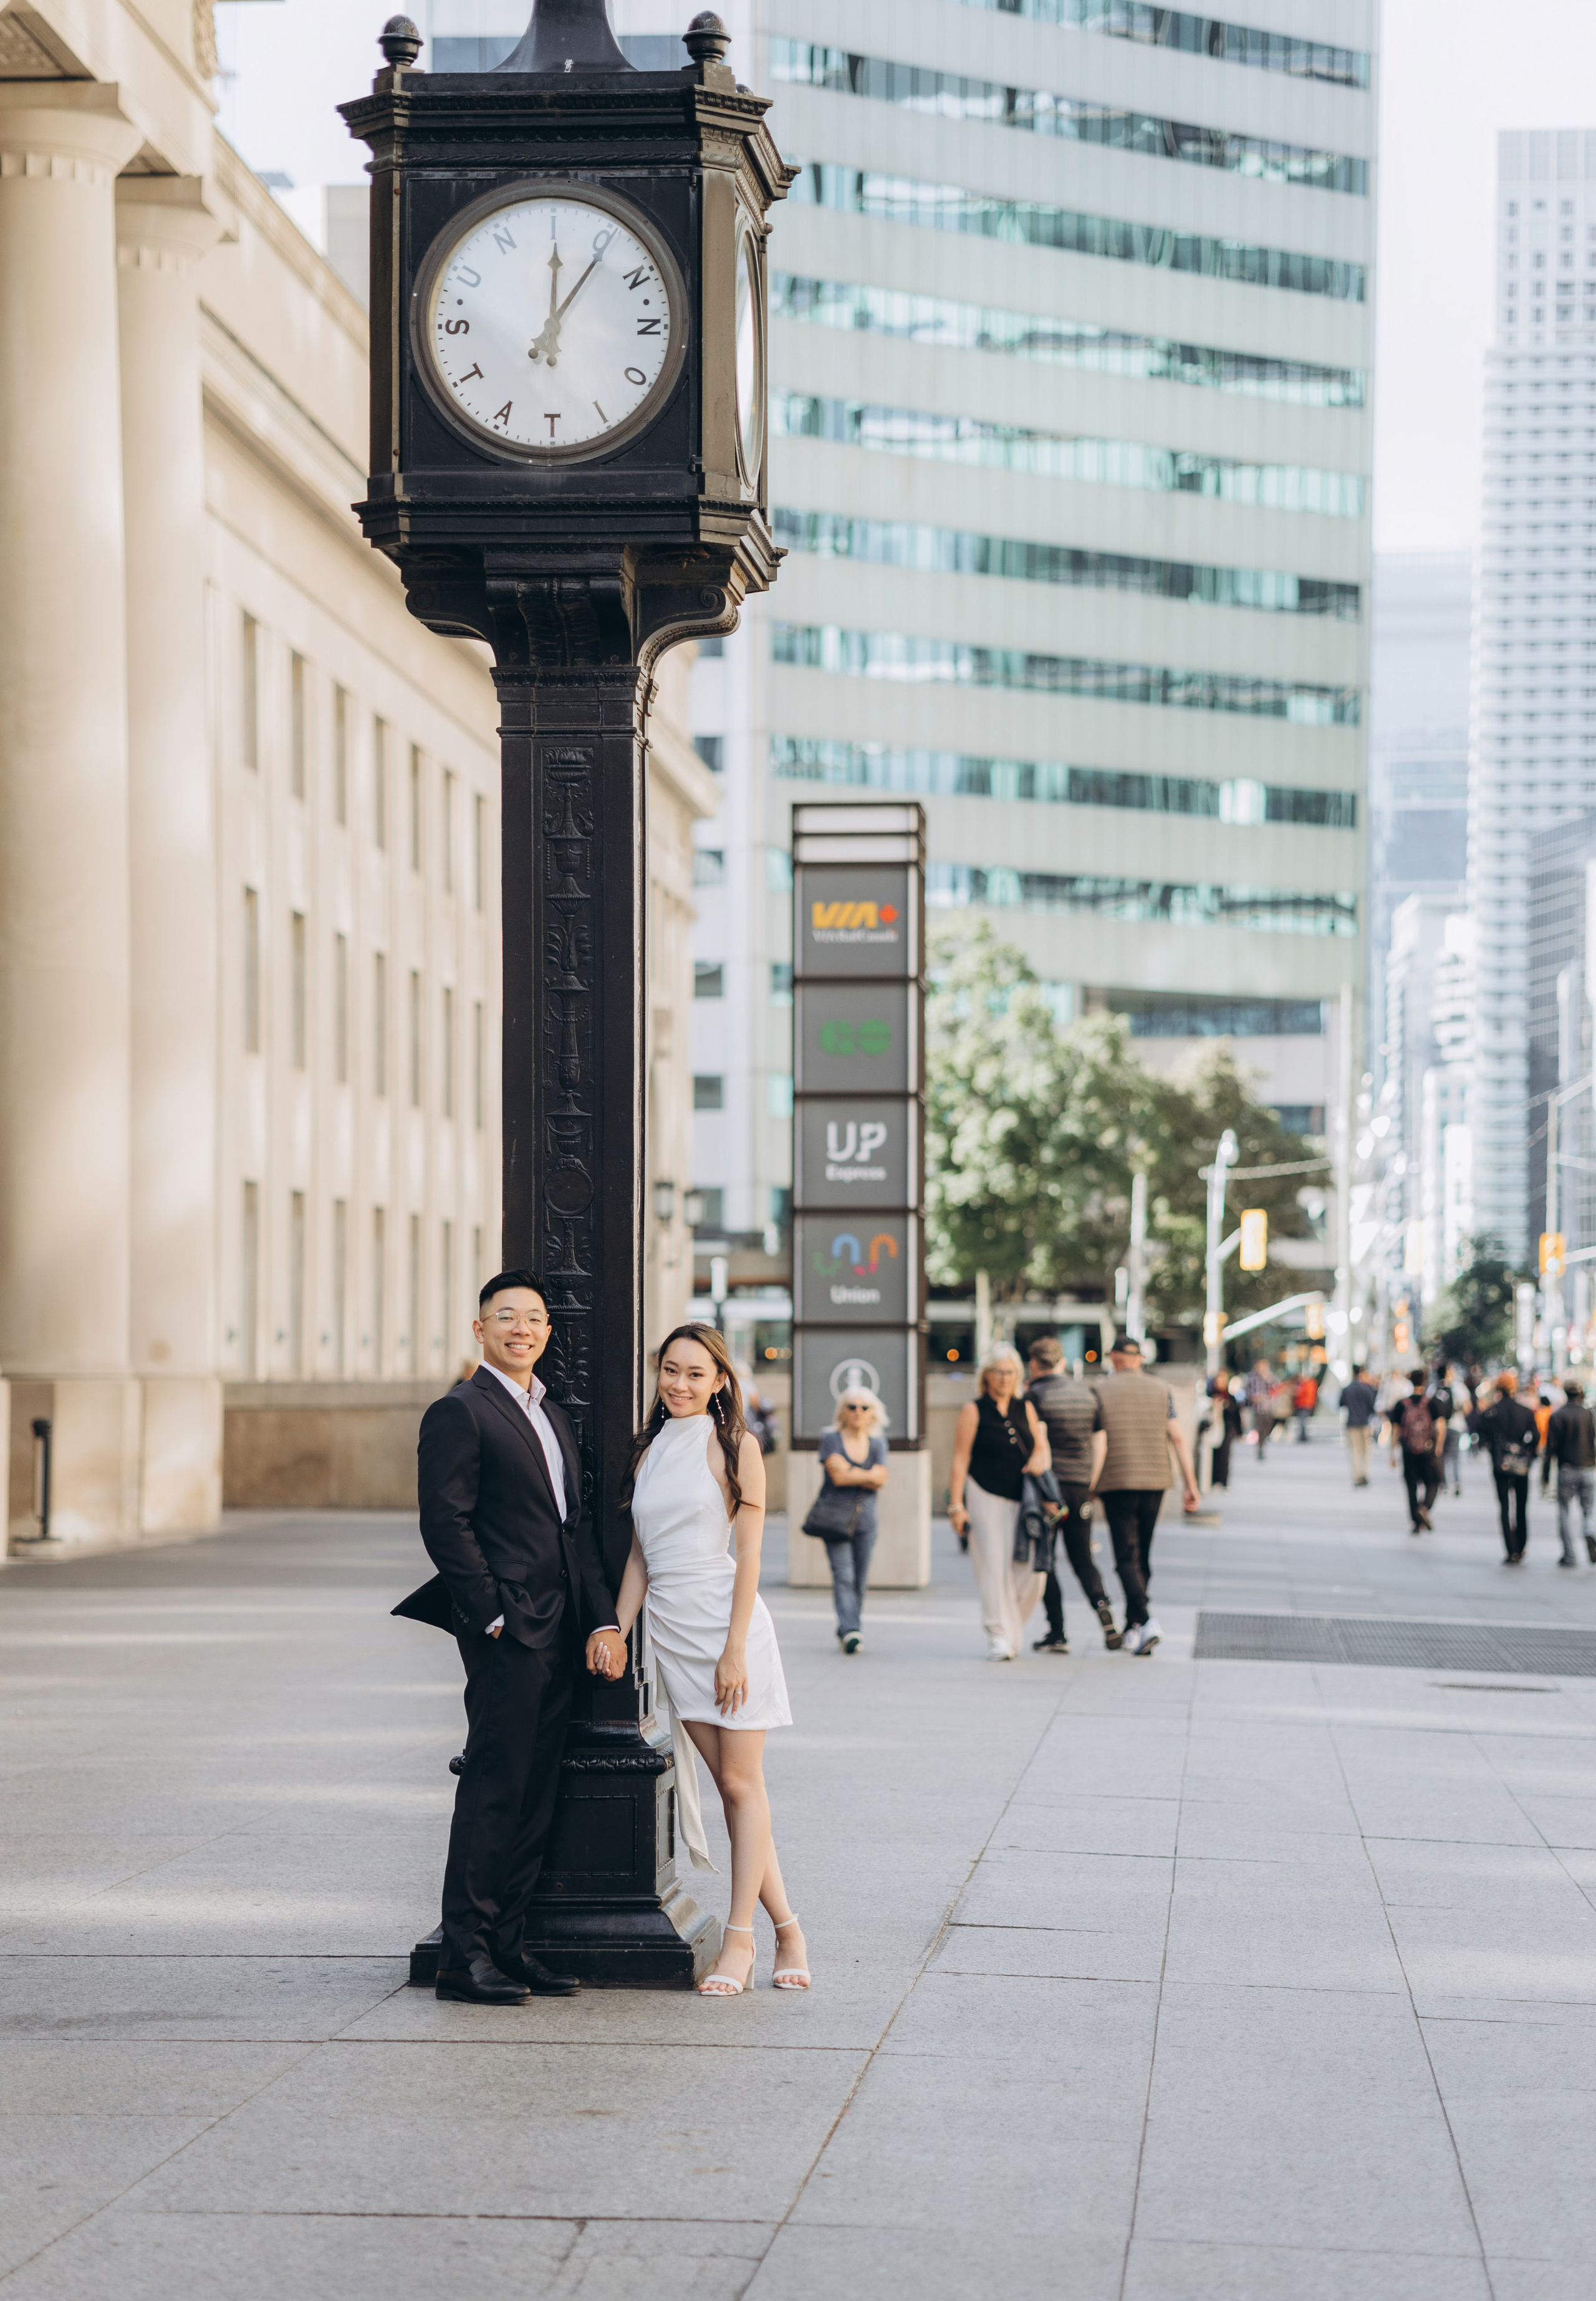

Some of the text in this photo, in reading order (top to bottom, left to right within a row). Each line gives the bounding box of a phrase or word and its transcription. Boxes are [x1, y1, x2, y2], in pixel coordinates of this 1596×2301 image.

[812, 900, 878, 930] VIA
[826, 1121, 887, 1162] UP
[825, 1164, 887, 1183] Express
[830, 1285, 880, 1304] Union
